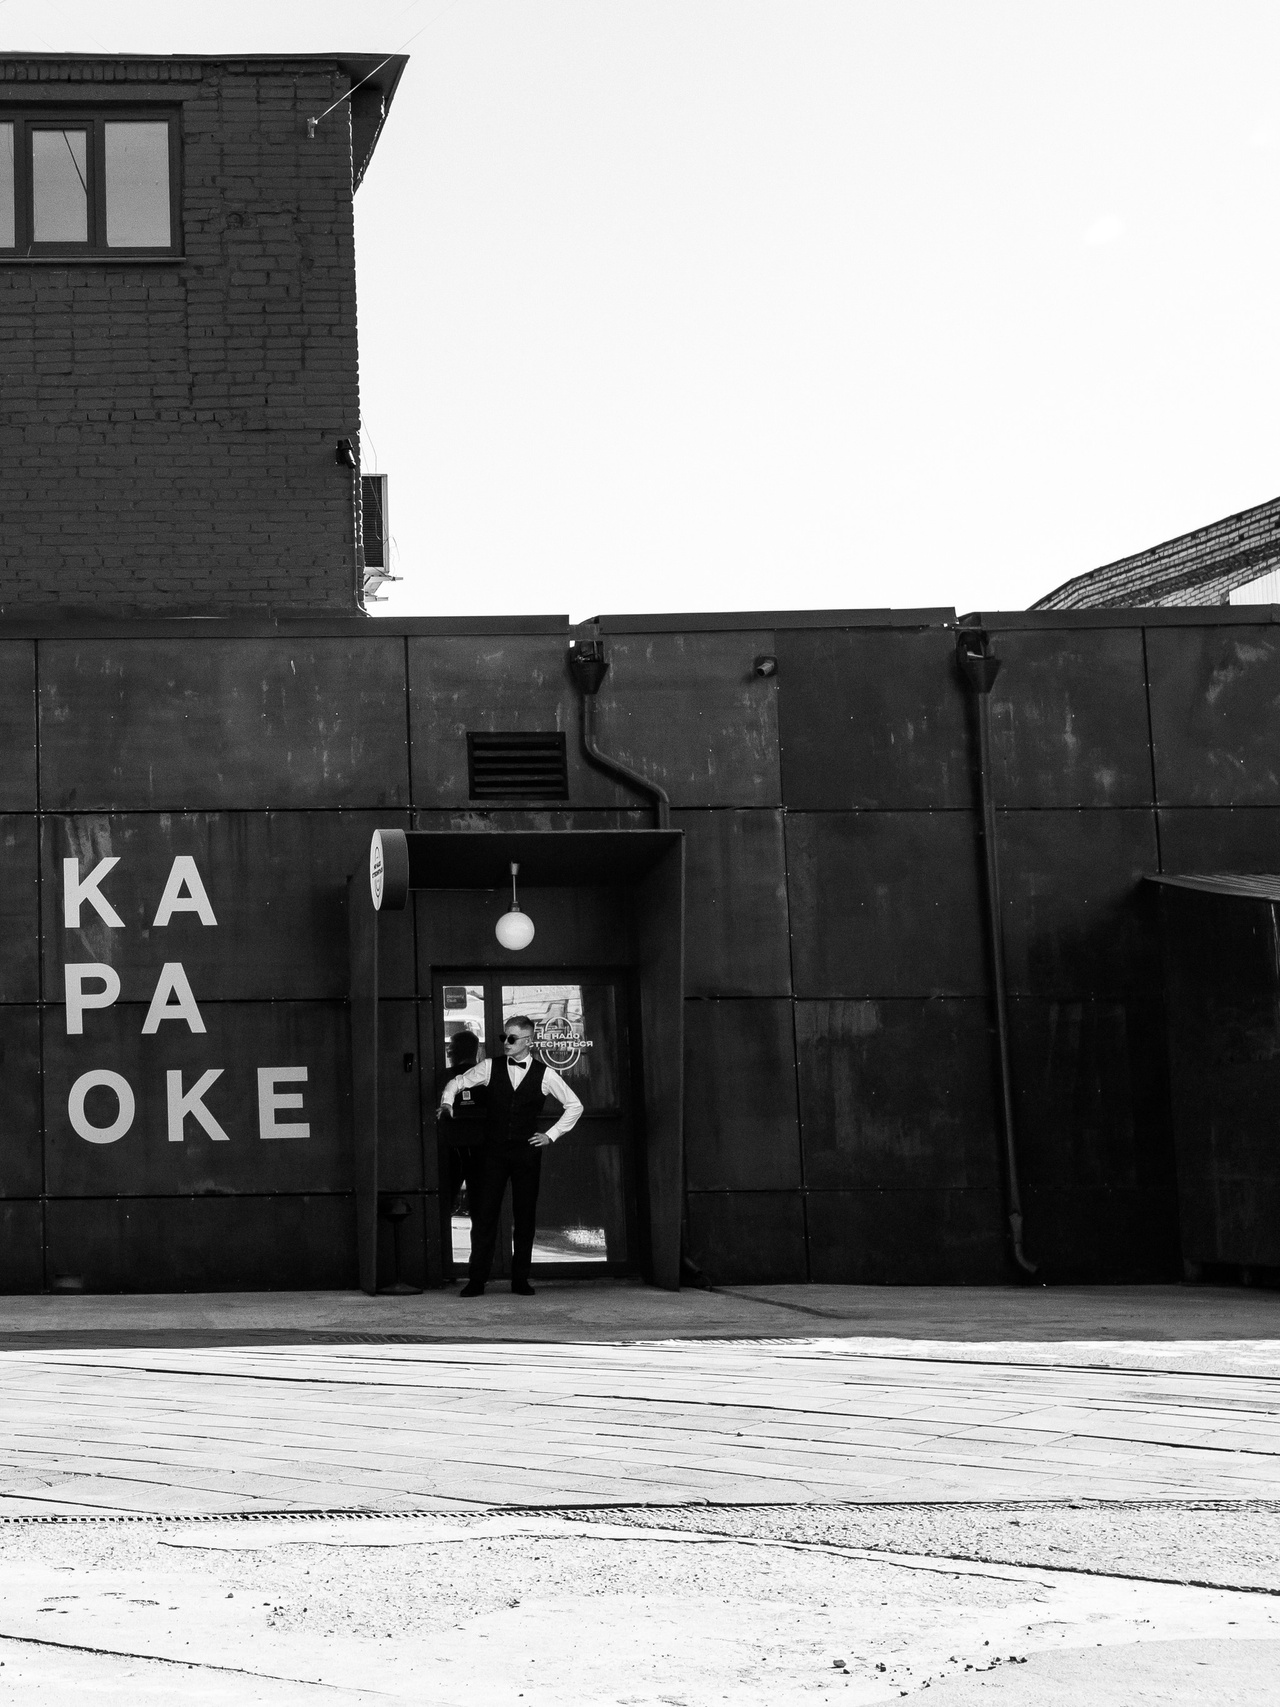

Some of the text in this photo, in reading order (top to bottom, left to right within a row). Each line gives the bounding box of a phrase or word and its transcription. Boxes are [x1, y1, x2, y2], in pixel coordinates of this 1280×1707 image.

[63, 855, 218, 928] КА
[64, 962, 207, 1035] РА
[68, 1066, 310, 1144] ОКЕ
